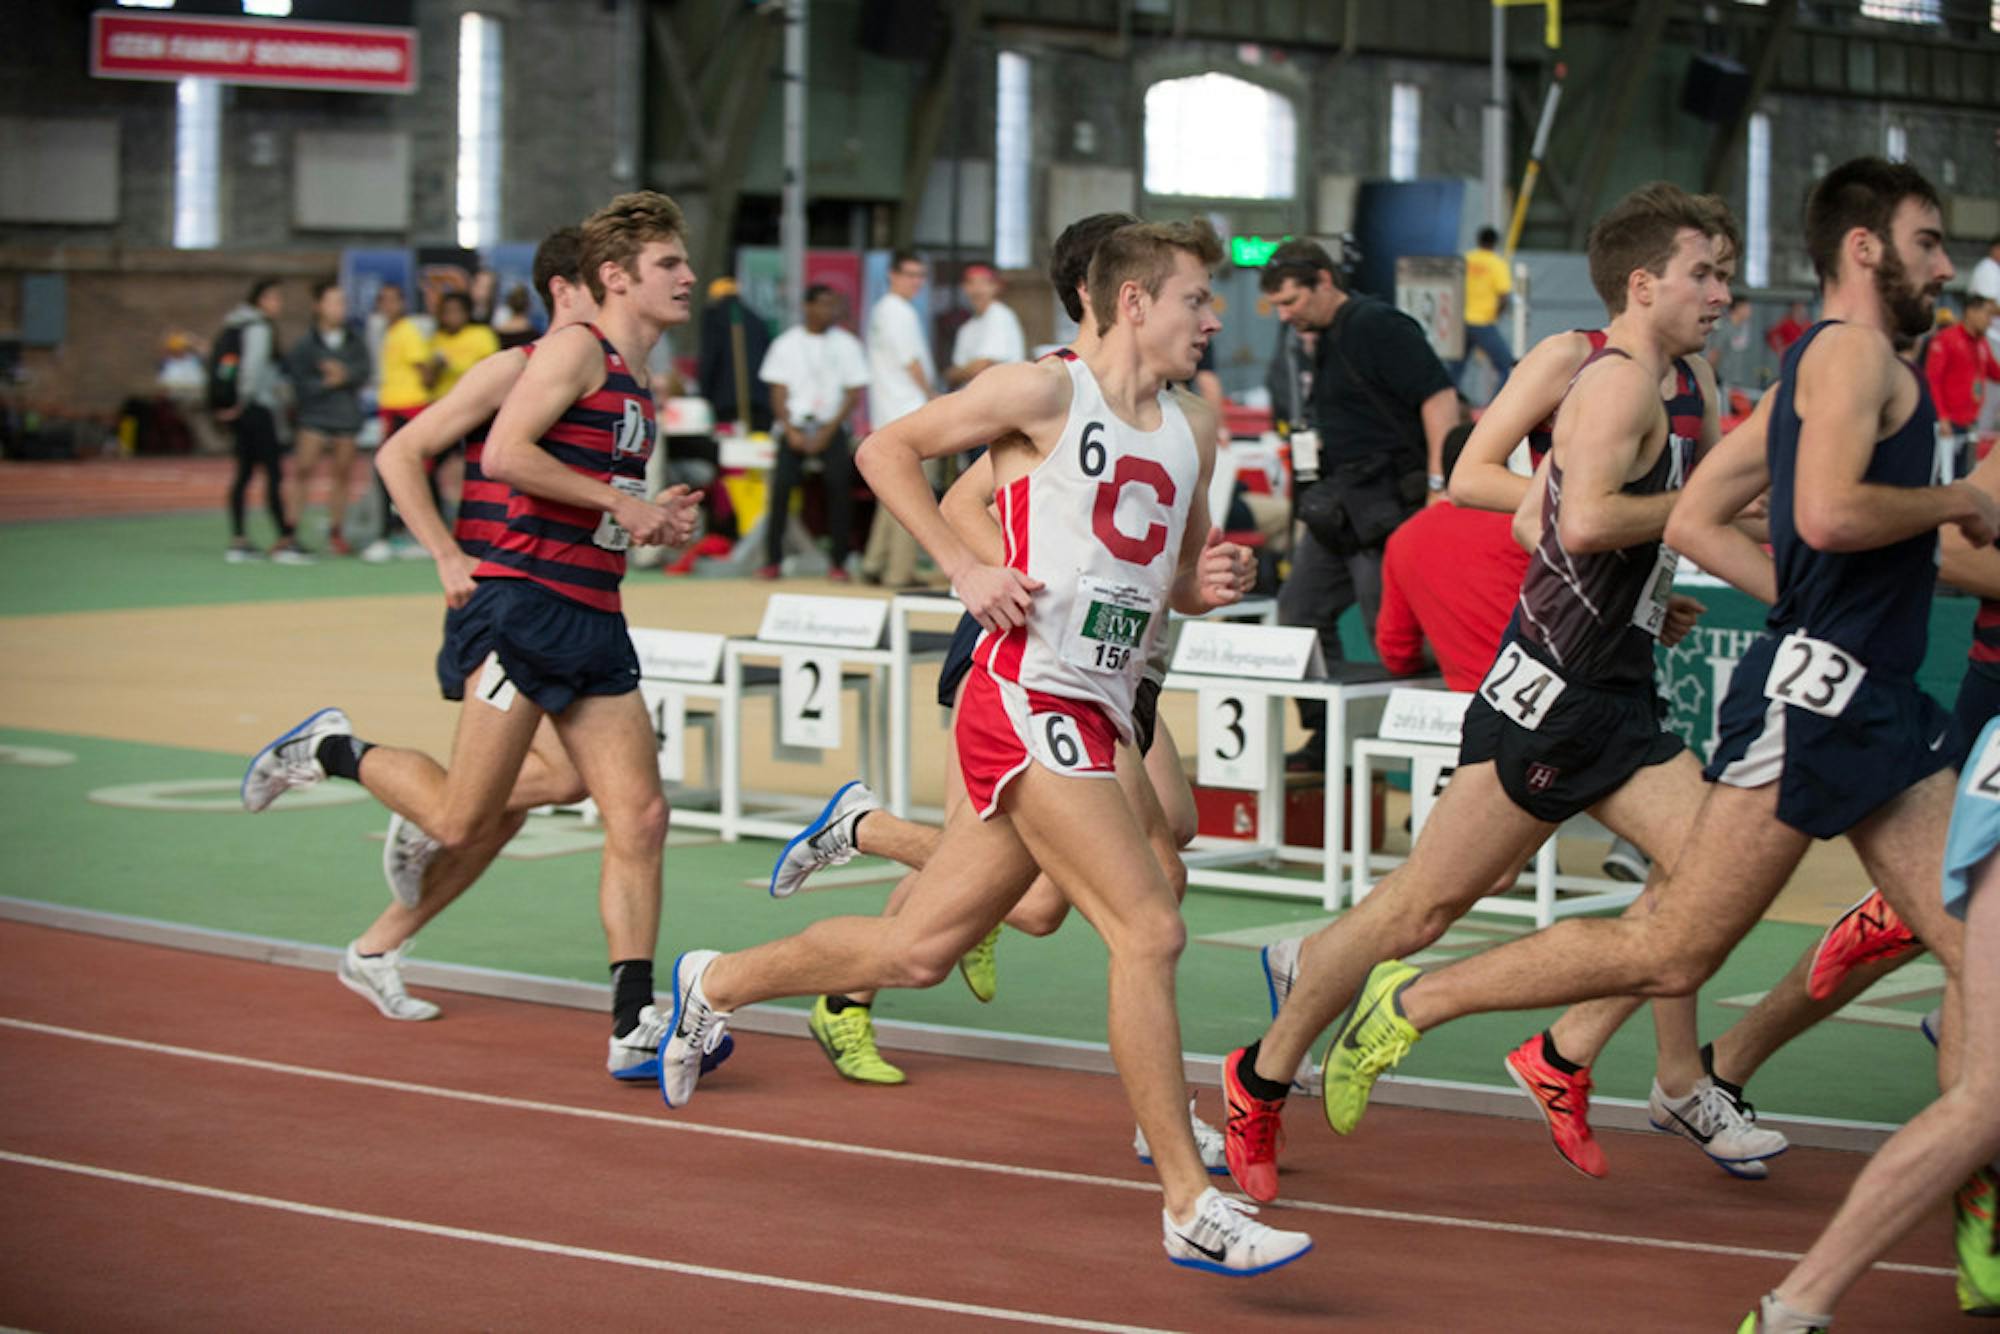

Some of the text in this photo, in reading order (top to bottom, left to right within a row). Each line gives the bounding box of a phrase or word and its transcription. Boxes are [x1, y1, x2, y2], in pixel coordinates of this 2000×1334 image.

[168, 36, 248, 64] FAMILY
[1079, 421, 1107, 477] 6
[1092, 454, 1176, 566] C
[1107, 614, 1142, 638] IVY
[799, 660, 841, 719] 2
[1486, 651, 1553, 720] 24
[1776, 642, 1849, 708] 23
[1046, 715, 1079, 767] 6
[1214, 697, 1246, 760] 3
[1529, 768, 1552, 788] H
